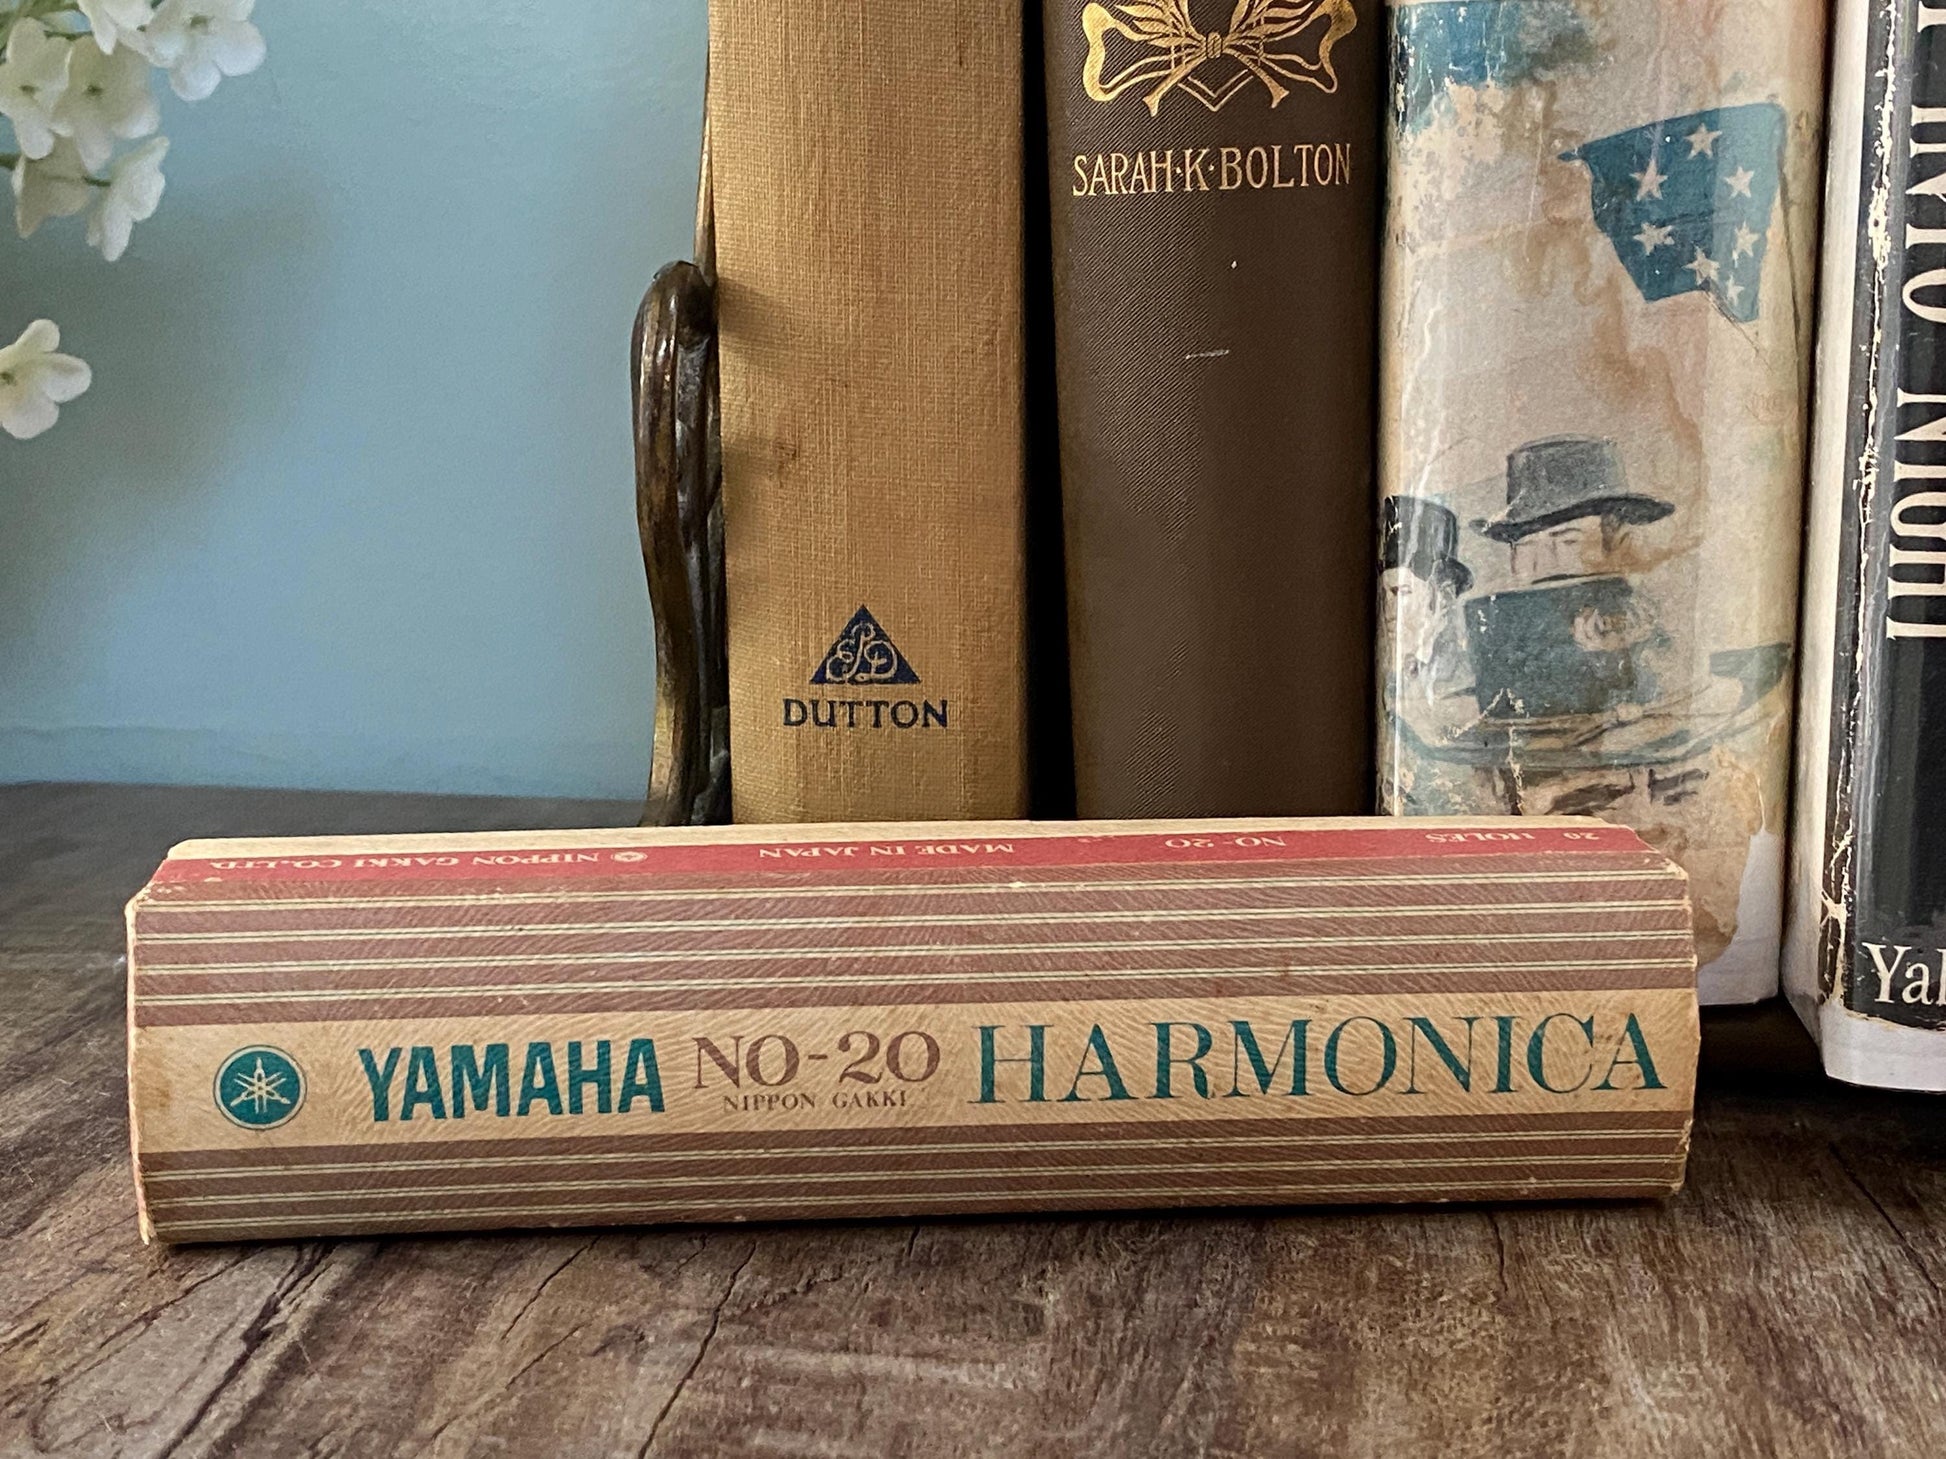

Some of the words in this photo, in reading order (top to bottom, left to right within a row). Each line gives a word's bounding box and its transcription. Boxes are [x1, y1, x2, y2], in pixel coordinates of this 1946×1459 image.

[783, 698, 948, 728] DUTTON
[1424, 831, 1536, 844] HOLES
[759, 846, 859, 858] JAPAN
[870, 845, 905, 856] IN
[914, 842, 1015, 855] MADE
[354, 856, 460, 867] GAKKI
[472, 852, 600, 865] NIPPON
[358, 1038, 665, 1121] YAMAHA
[692, 1030, 941, 1089] NO-20
[970, 1012, 1669, 1103] HARMONICA
[723, 1092, 816, 1112] NIPPON
[832, 1089, 907, 1110] GAKKI
